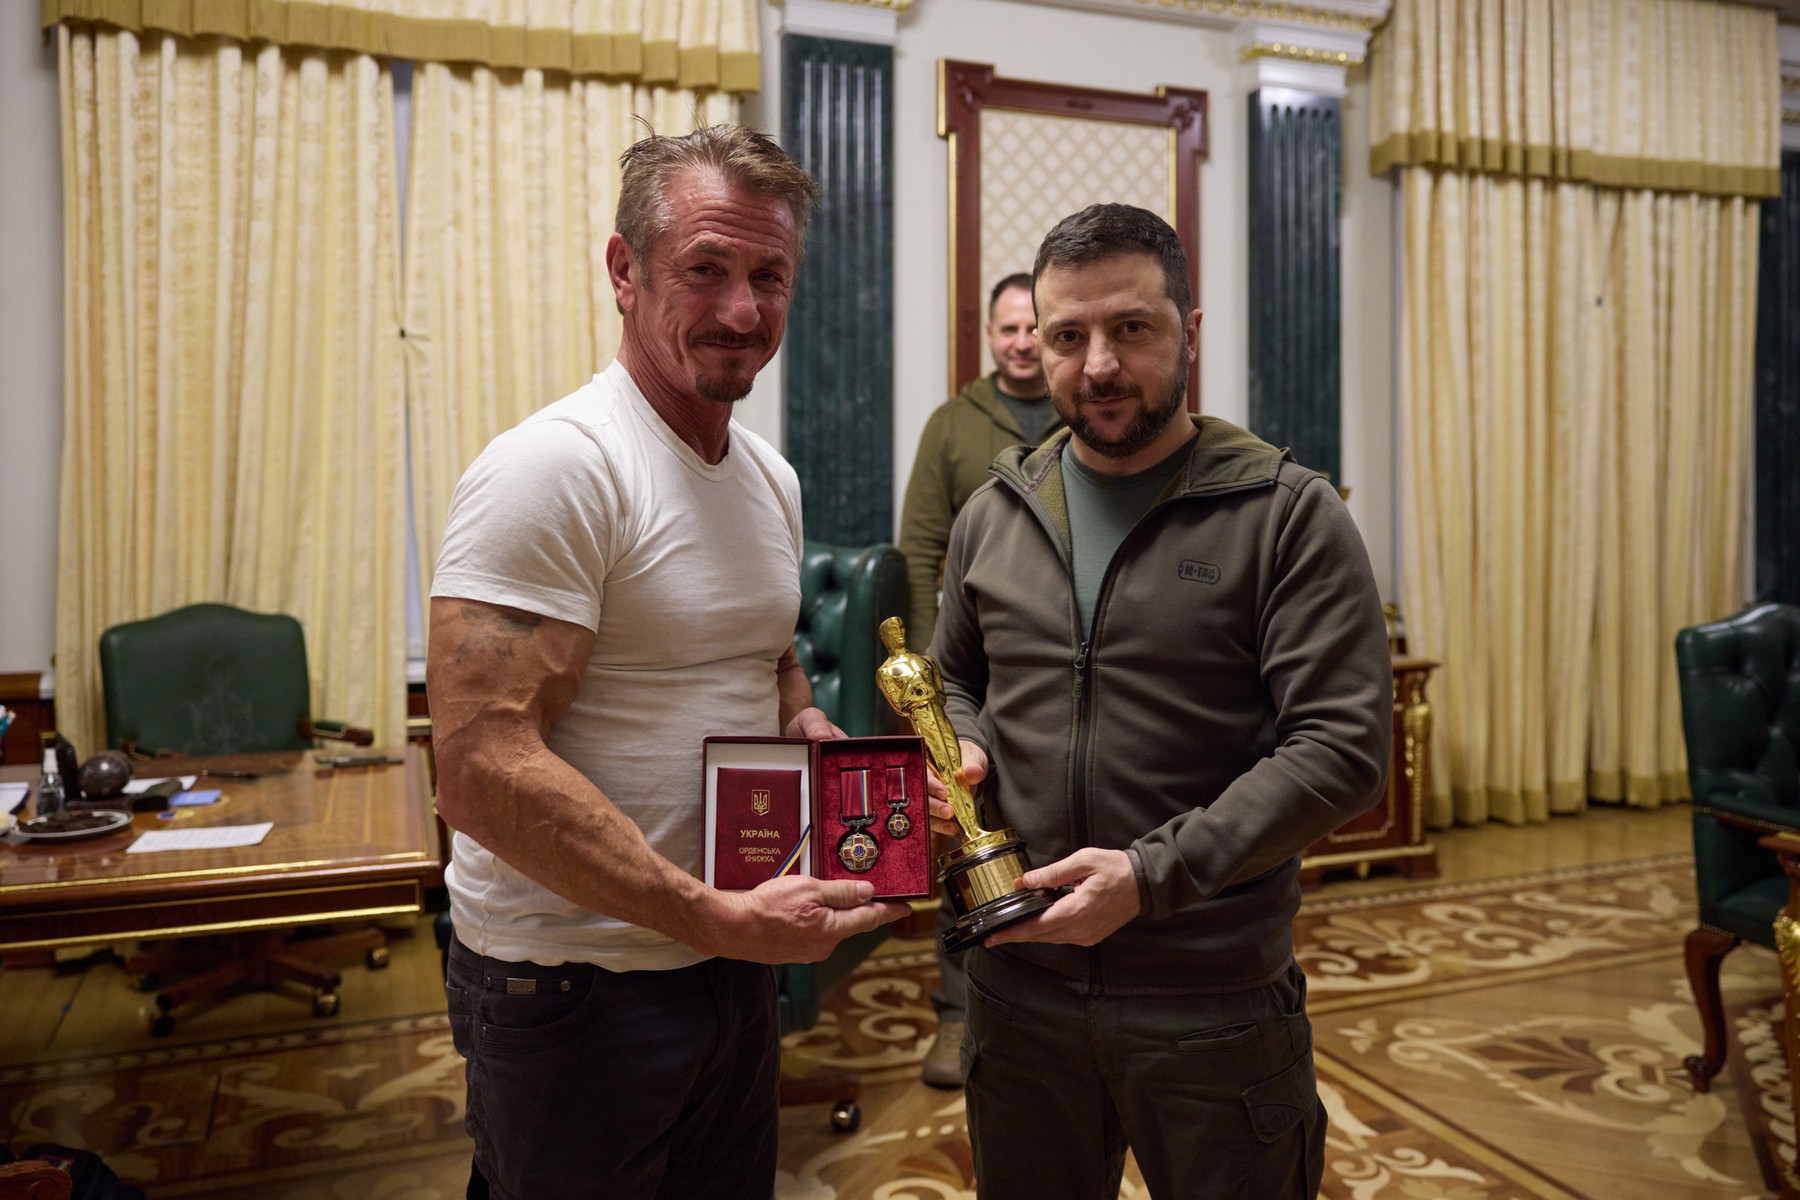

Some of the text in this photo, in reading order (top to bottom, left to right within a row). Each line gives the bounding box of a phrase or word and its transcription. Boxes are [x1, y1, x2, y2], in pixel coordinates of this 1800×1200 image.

[740, 828, 780, 838] УКРАЇНА
[739, 847, 781, 855] ОРДЕНСЬКА
[745, 855, 774, 863] КНИЖКА
